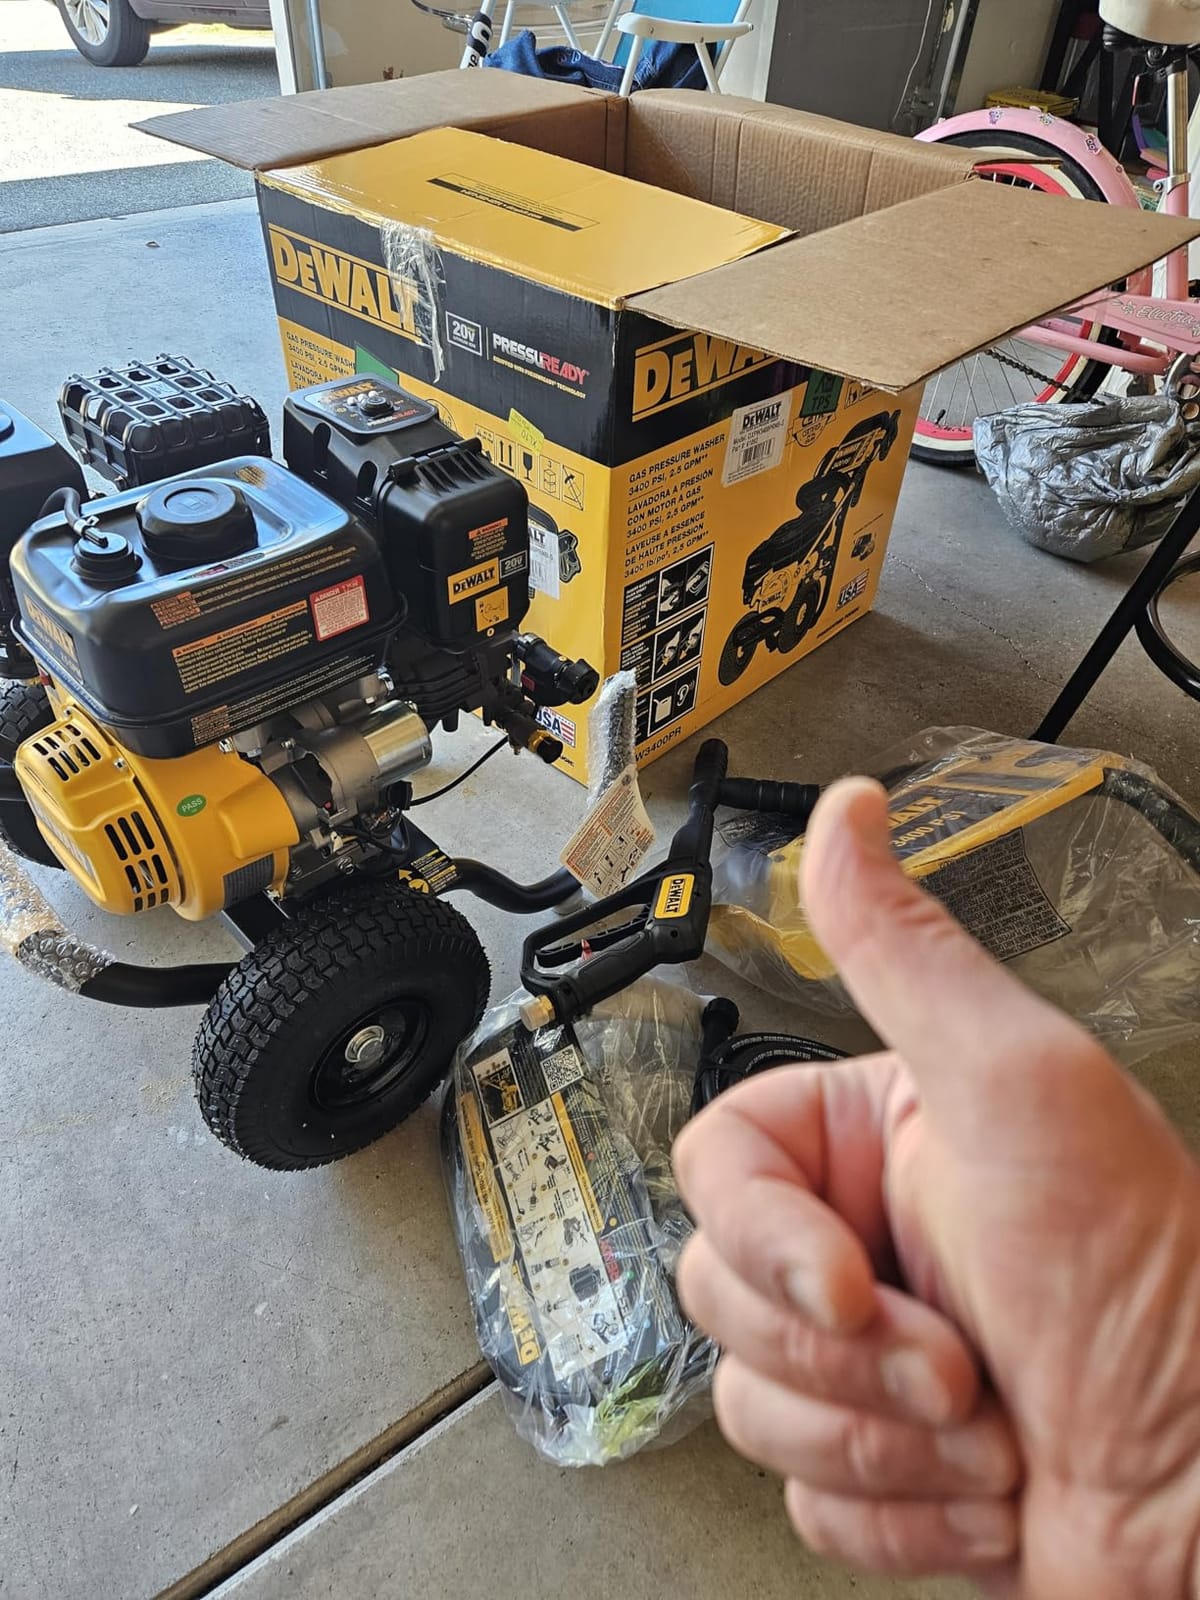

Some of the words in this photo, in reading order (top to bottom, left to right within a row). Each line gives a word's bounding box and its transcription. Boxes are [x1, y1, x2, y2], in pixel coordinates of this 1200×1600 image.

[335, 355, 355, 369] WASH
[743, 402, 782, 429] DEWALT
[629, 469, 647, 483] GAS
[648, 450, 691, 474] PRESSURE
[693, 433, 725, 455] WASHER
[628, 481, 650, 496] 3400
[652, 475, 667, 486] PSI,
[669, 465, 682, 477] 2.5
[627, 513, 645, 526] CON
[647, 498, 677, 517] MOTOR
[685, 486, 701, 498] GAS
[628, 489, 671, 515] LAVADORA
[672, 485, 678, 493] A
[625, 532, 661, 556] LAVEUSE
[671, 511, 705, 533] ESSENCE
[625, 555, 636, 567] DE
[638, 543, 665, 561] HAUTE
[667, 523, 704, 550] PRESSION
[626, 524, 647, 538] 3400
[453, 567, 495, 595] DEWALT
[624, 563, 644, 578] 3400
[181, 798, 203, 812] PASS
[891, 826, 934, 847] 3400
[665, 878, 685, 912] DEWALT
